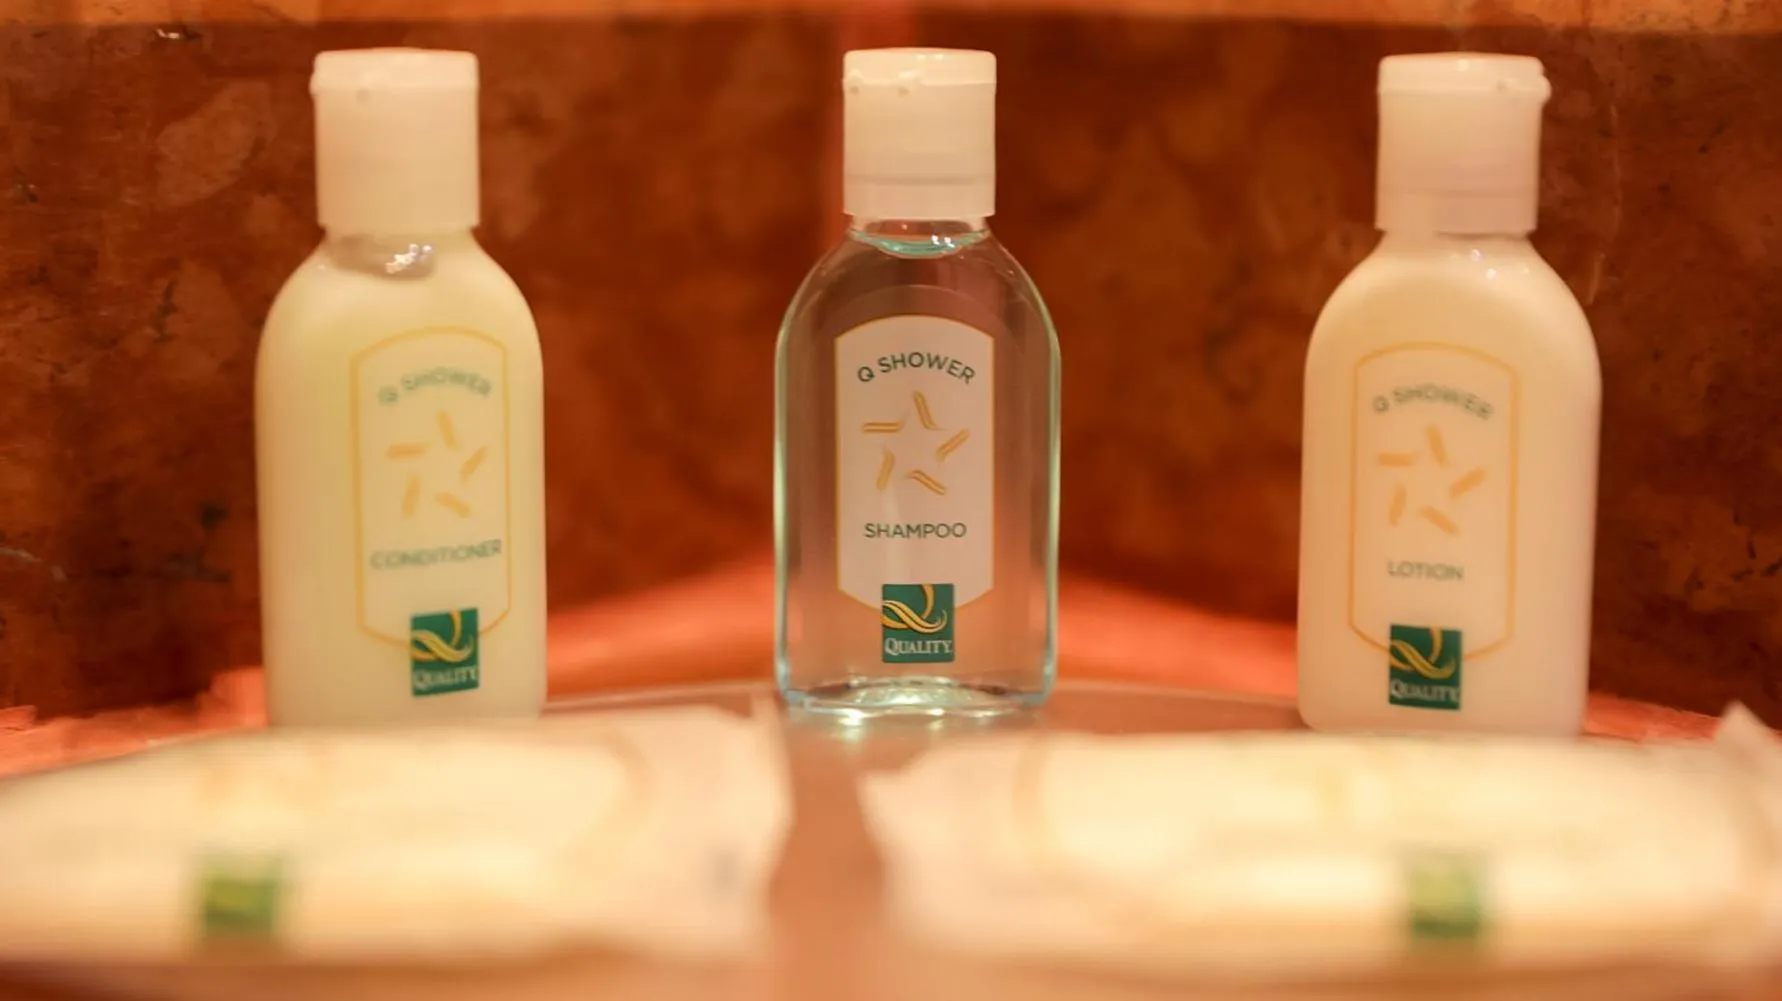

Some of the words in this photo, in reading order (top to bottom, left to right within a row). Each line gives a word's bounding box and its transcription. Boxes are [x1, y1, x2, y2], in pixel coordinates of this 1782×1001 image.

[857, 365, 876, 383] Q
[877, 351, 976, 385] SHOWER
[401, 366, 492, 398] SHOWER
[1392, 383, 1494, 420] SHOWER
[863, 522, 967, 540] SHAMPOO
[369, 538, 503, 570] CONDITIONER
[1386, 560, 1465, 581] LOTION
[884, 637, 953, 657] QUALITY
[412, 664, 478, 691] QUALITY
[1390, 678, 1460, 702] QUALITY
